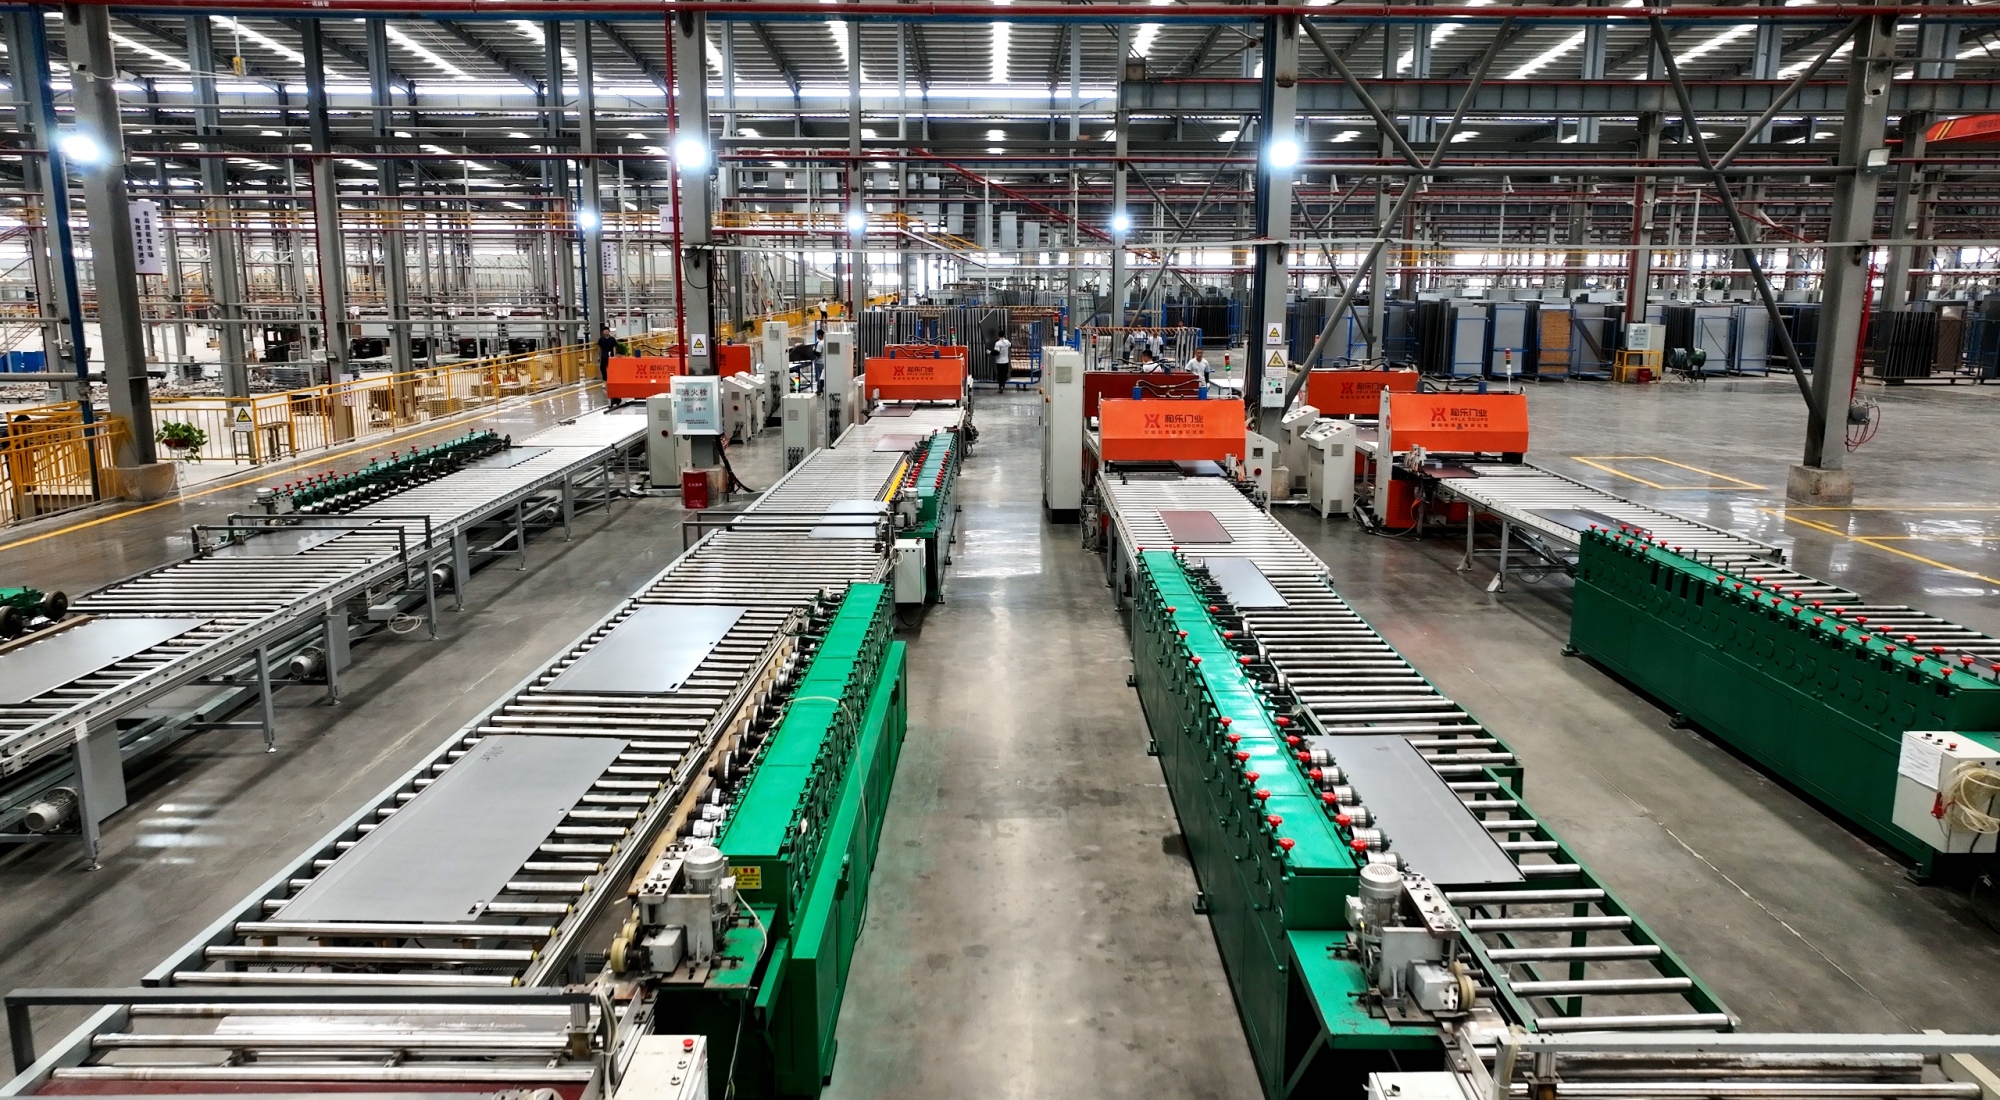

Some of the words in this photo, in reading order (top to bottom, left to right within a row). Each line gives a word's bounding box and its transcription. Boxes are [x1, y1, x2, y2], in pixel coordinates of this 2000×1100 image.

[681, 388, 708, 397] 消火栓
[1450, 407, 1488, 417] 和乐门业
[1164, 414, 1204, 424] 和乐门业
